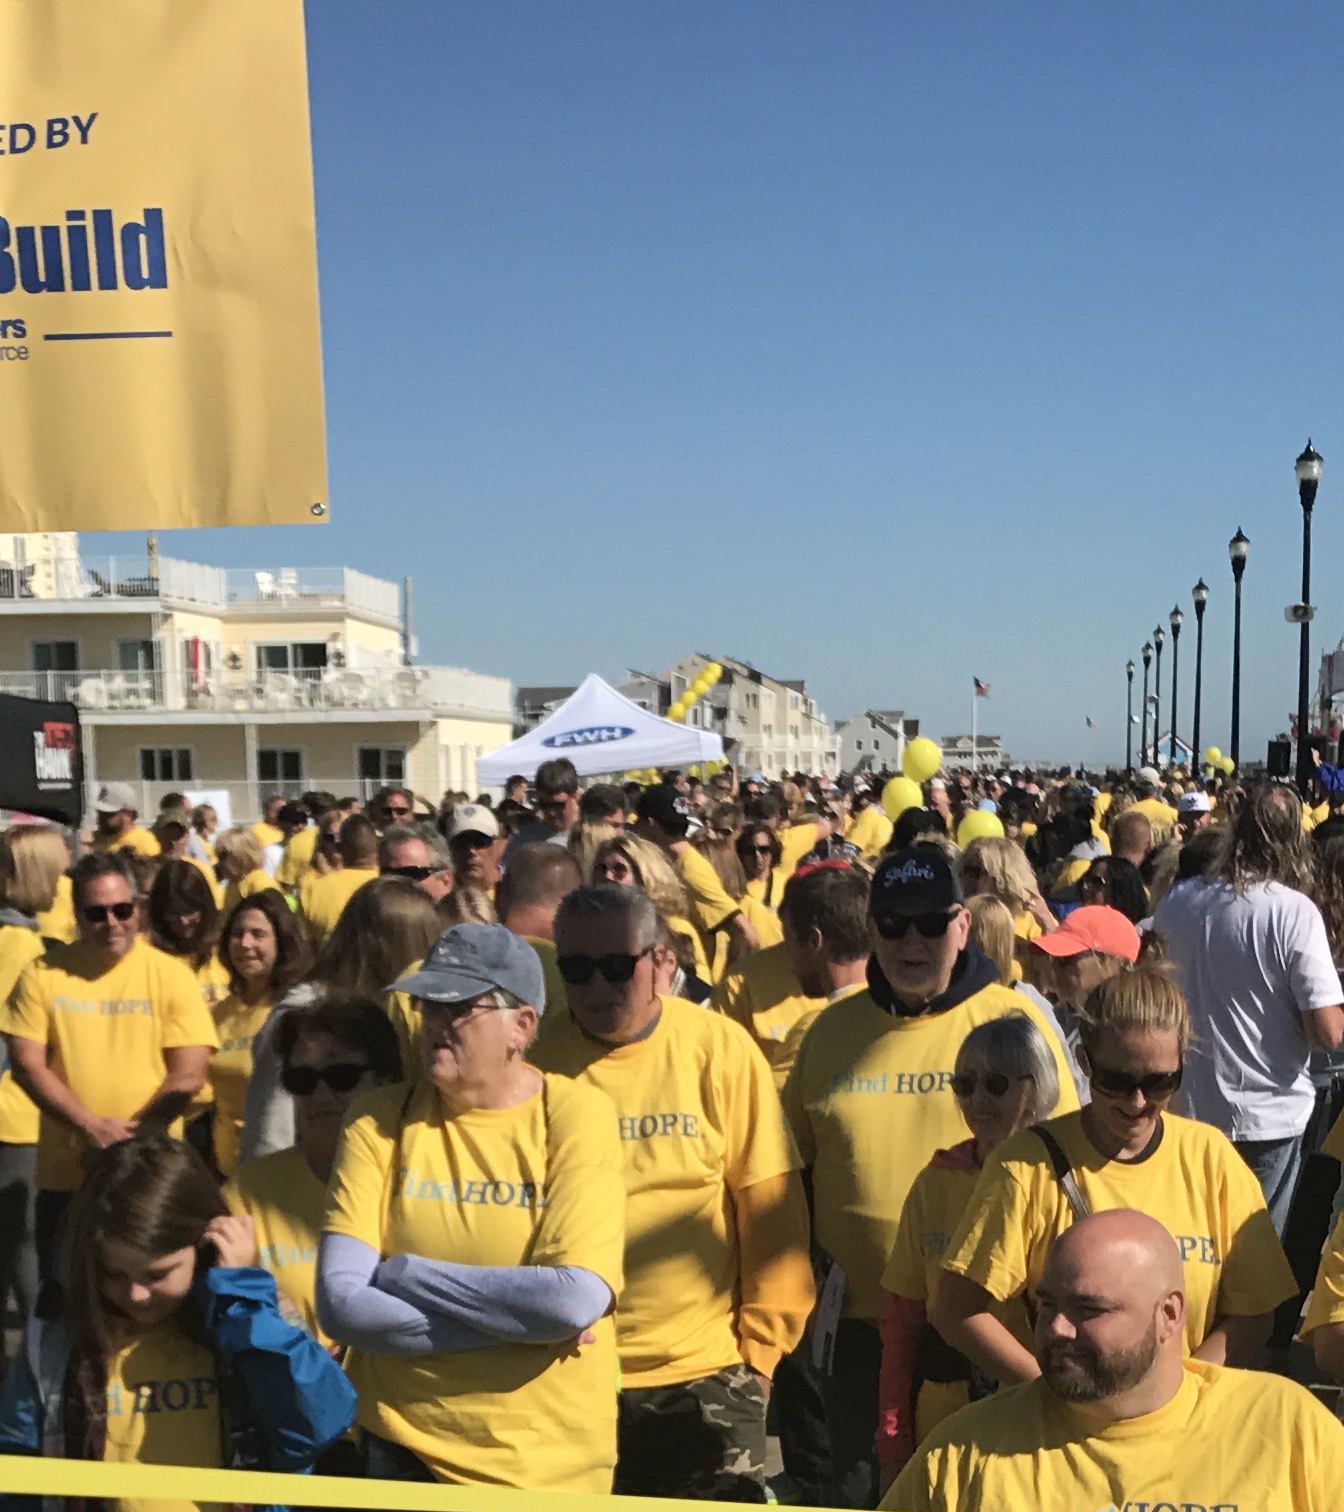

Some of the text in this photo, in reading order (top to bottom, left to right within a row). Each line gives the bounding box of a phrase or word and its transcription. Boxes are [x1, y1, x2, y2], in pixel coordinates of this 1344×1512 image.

[46, 113, 98, 149] BY
[553, 727, 622, 746] FWH
[830, 1071, 955, 1094] Find HOP
